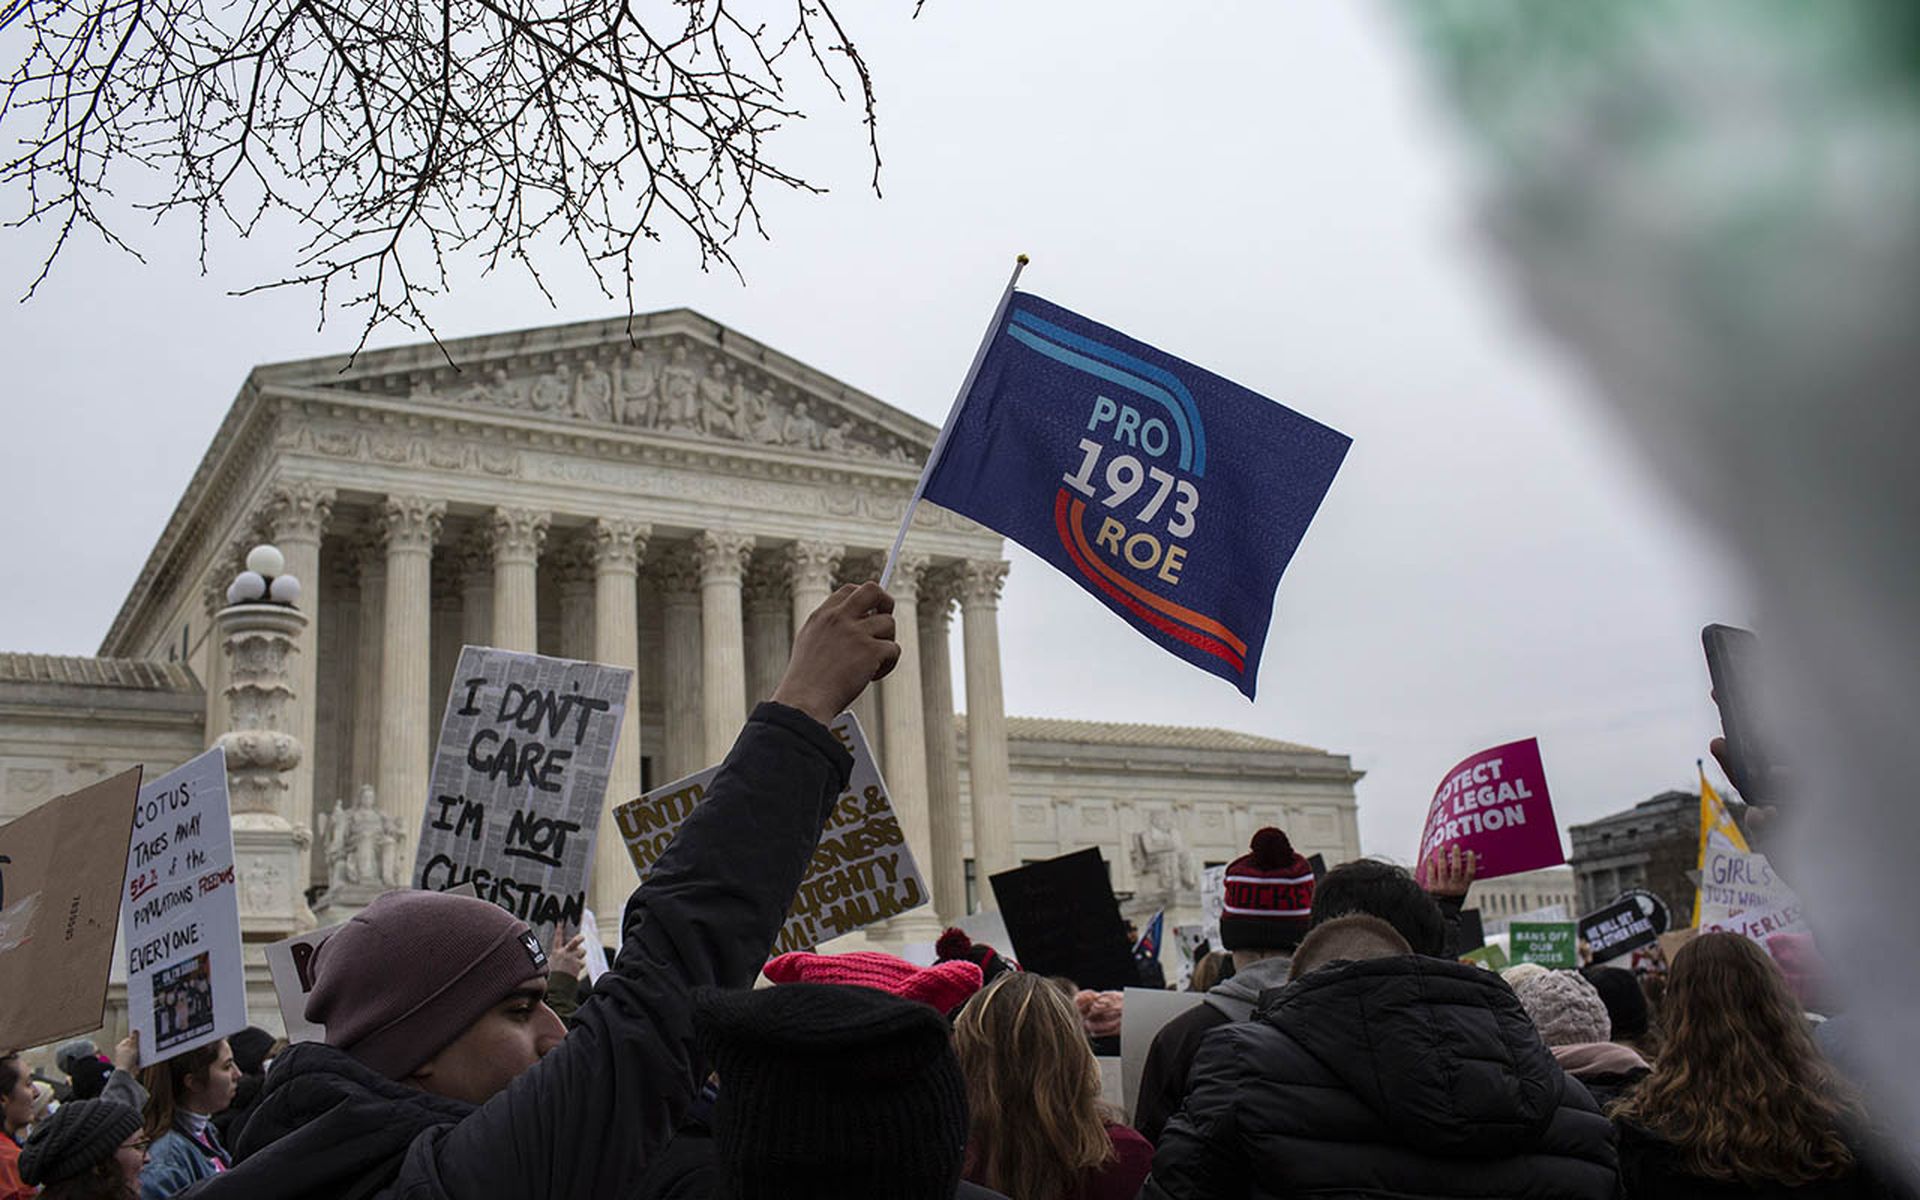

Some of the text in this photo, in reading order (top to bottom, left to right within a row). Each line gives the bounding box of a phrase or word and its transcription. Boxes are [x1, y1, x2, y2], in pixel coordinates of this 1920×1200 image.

[1087, 395, 1169, 457] PRO
[1062, 438, 1200, 539] 1973
[1096, 516, 1188, 585] ROE
[458, 678, 610, 745] I DON'T
[467, 729, 573, 793] CARE
[135, 782, 196, 829] COTUS:
[864, 785, 890, 814] &
[1453, 778, 1533, 815] LEGAL
[133, 812, 202, 868] TAKES AWAY
[431, 795, 581, 859] I'M NOT
[186, 849, 207, 870] the
[1712, 853, 1771, 886] GIRLS
[1704, 883, 1735, 905] JUST
[129, 922, 204, 974] EVERYONE:
[1598, 918, 1619, 934] WILL
